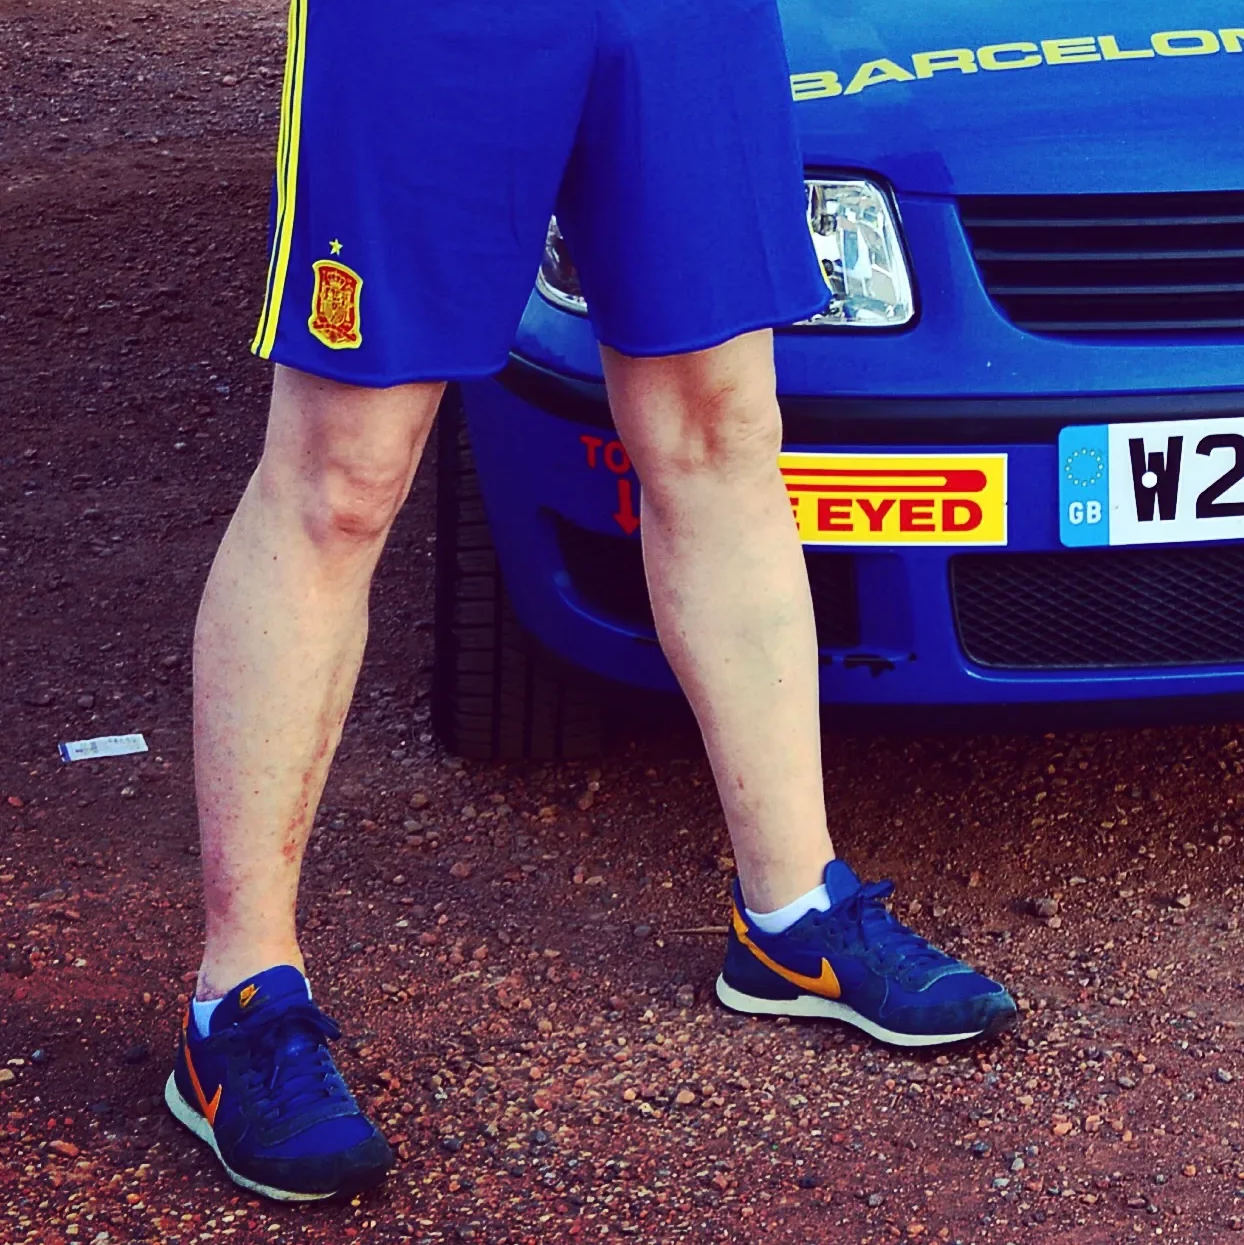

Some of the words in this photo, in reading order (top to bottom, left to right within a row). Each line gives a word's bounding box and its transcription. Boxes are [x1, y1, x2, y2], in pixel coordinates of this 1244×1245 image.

[579, 435, 631, 475] TO
[816, 497, 984, 533] EYED
[1068, 500, 1102, 525] GB
